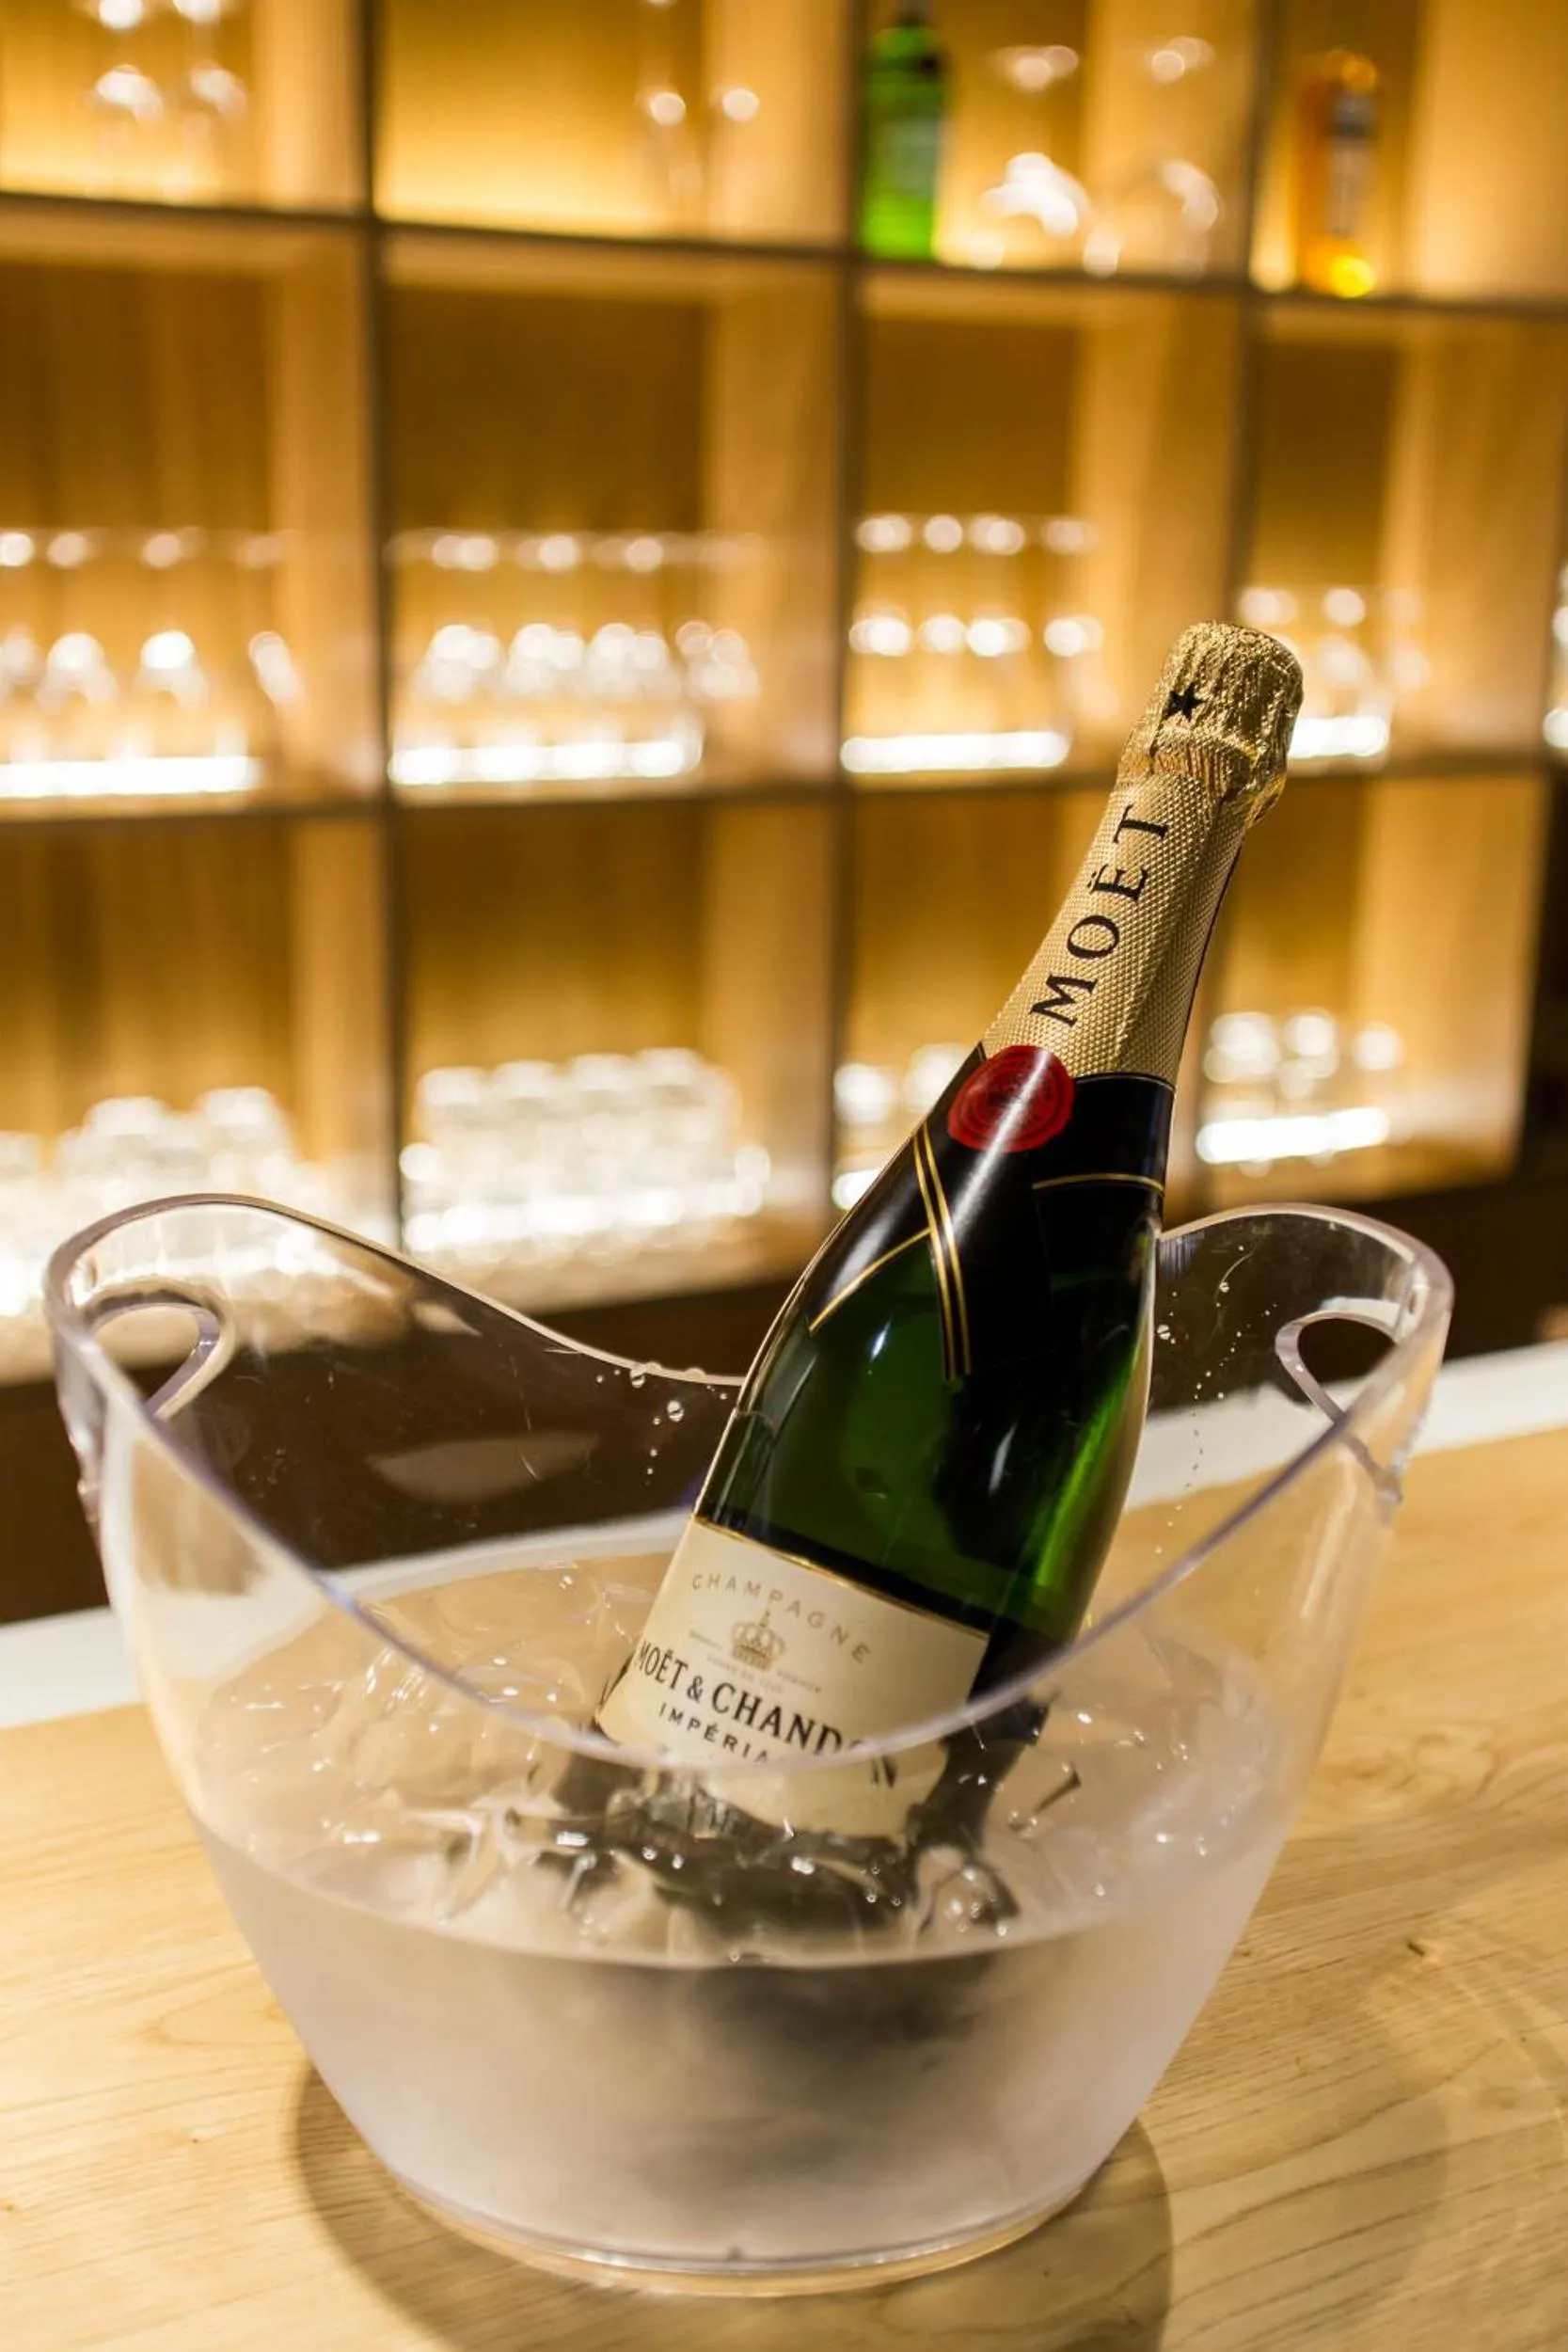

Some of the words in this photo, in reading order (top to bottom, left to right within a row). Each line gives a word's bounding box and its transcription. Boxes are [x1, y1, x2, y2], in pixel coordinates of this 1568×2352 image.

[1030, 804, 1169, 1027] MOËT
[691, 1573, 872, 1664] CHAMPAGNE
[658, 1702, 770, 1764] IMPÉRIA
[687, 1675, 704, 1704] &
[712, 1682, 895, 1786] CHAND
